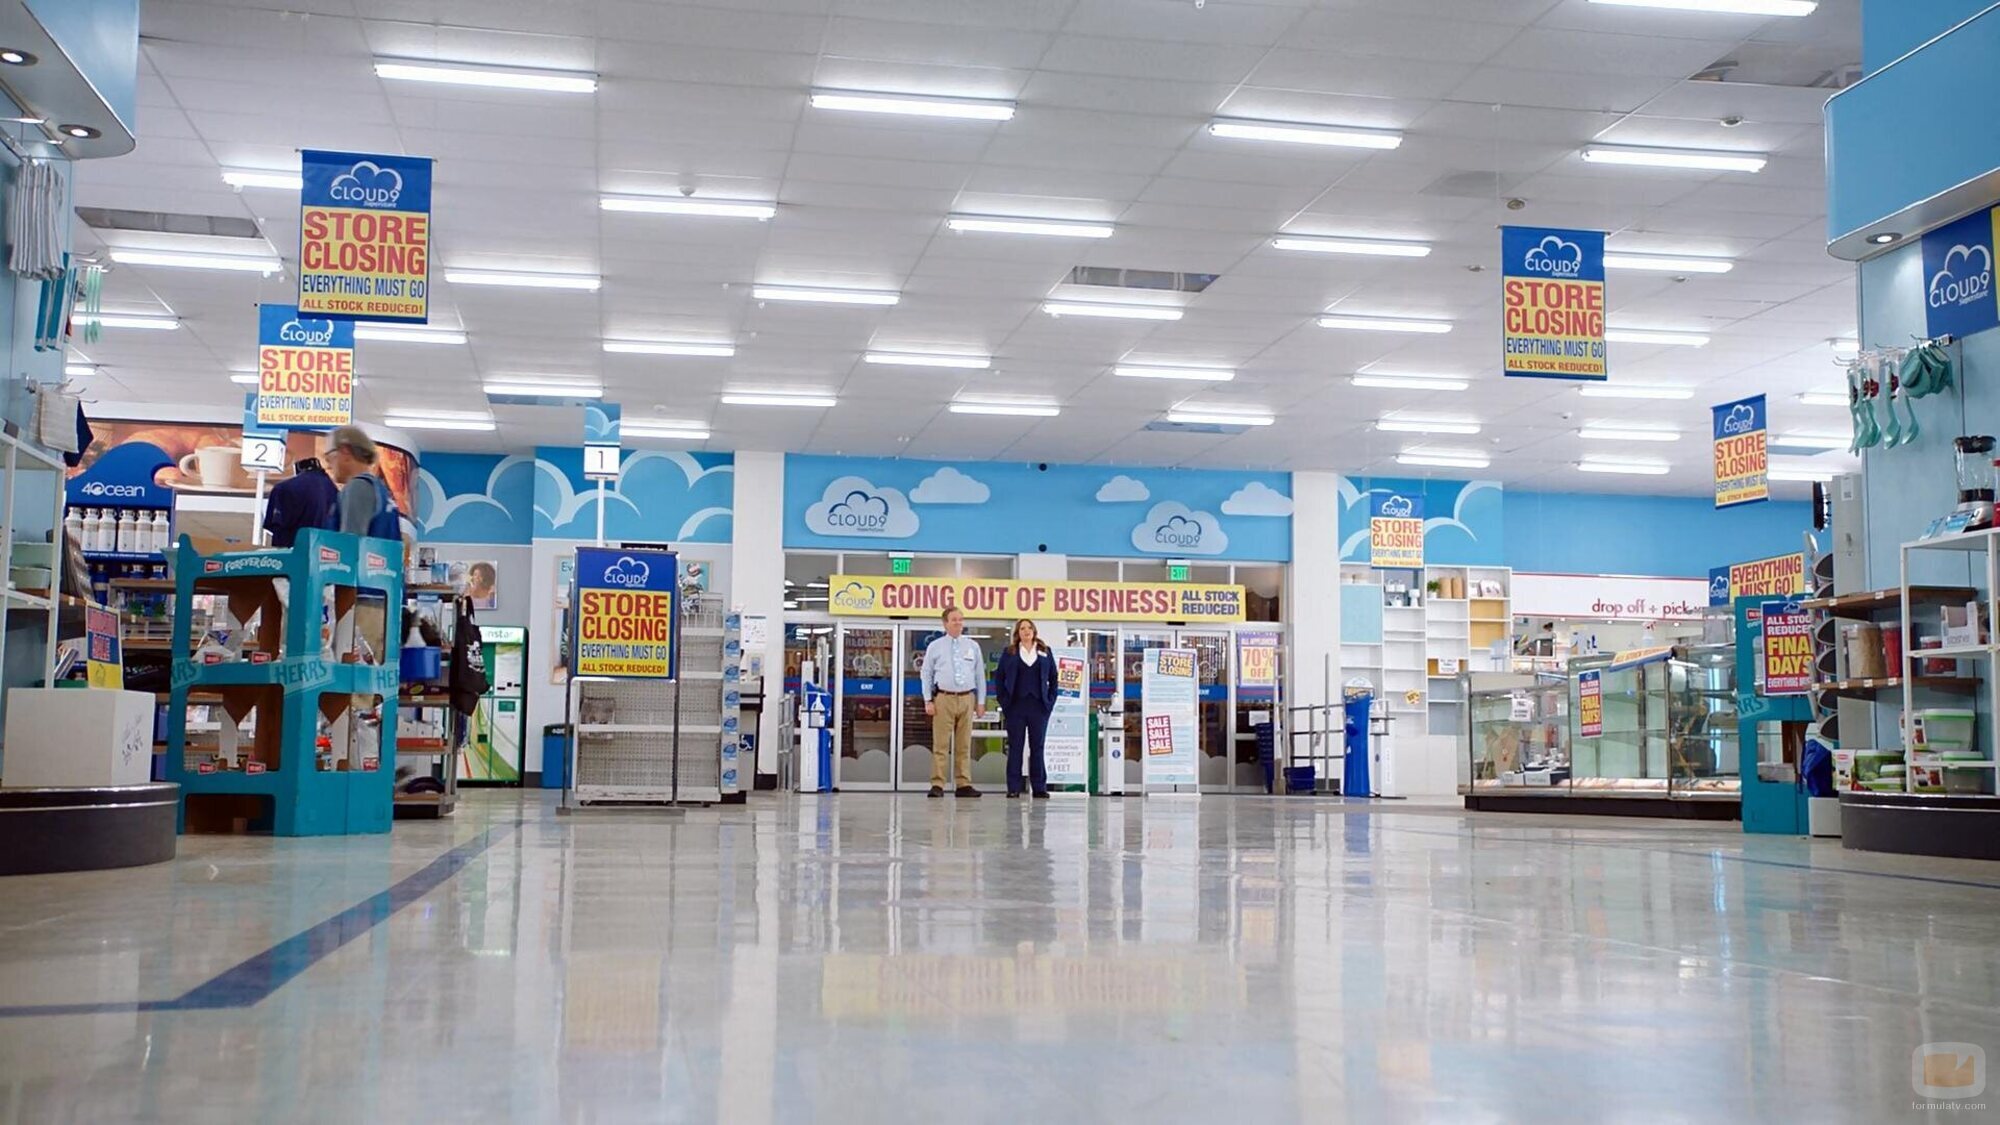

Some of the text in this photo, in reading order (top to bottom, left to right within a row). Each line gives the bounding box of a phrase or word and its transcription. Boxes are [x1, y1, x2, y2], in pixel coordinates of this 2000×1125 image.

[330, 186, 400, 202] CLOUD9
[304, 211, 426, 245] STORE
[303, 241, 425, 275] CLOSING
[1525, 258, 1580, 273] CLOUD9
[302, 274, 424, 298] EVERYTHING MUST GO
[1929, 271, 1990, 308] CLOUD9
[1506, 281, 1602, 310] STORE
[303, 299, 423, 314] ALL STOCK REDUCED!
[1506, 307, 1602, 337] CLOSING
[280, 330, 332, 342] CLOUD9
[1506, 337, 1603, 358] EVERYTHING MUST GO
[261, 349, 351, 373] STORE
[1508, 360, 1603, 373] ALL STOCK REDUCED!
[261, 371, 350, 395] CLOSING
[260, 396, 350, 412] EVERYTHING MUST GO
[261, 413, 275, 421] ALL
[279, 413, 305, 422] STOCK
[254, 443, 268, 462] 2
[1716, 433, 1765, 460] STORE
[598, 450, 604, 470] 1
[1716, 452, 1766, 478] CLOSING
[827, 514, 887, 527] CLOUD9
[1372, 519, 1422, 534] STORE
[1155, 533, 1200, 544] CLOUD9
[1372, 533, 1422, 548] CLOSING
[561, 562, 573, 571] Ev
[1731, 555, 1802, 585] EVERYTHING
[604, 574, 648, 585] CLOUD9
[1739, 580, 1771, 596] MUST
[1775, 576, 1794, 595] GO!
[881, 584, 1176, 614] GOING OUT OF BUSINESS!
[1181, 590, 1239, 602] ALL STOCK
[582, 592, 668, 618] STORE
[1182, 603, 1239, 616] REDUCED!
[1592, 598, 1623, 617] drop
[1627, 599, 1646, 613] off
[1767, 616, 1785, 626] ALL
[1787, 614, 1813, 624] STOC
[582, 616, 667, 641] CLOSING
[581, 643, 667, 660] EVERYTHING MUST GO
[1767, 636, 1811, 656] FINA
[1160, 656, 1193, 668] STORE
[1243, 648, 1274, 667] 70%
[582, 663, 665, 674] ALL STOCK REDUCED!
[1060, 669, 1079, 681] DEEP
[1159, 665, 1193, 677] CLOSING
[1250, 668, 1267, 678] OFF
[1147, 717, 1168, 729] SALE
[1149, 729, 1170, 740] SALE
[1150, 740, 1171, 751] SALE
[1053, 764, 1070, 772] FEET
